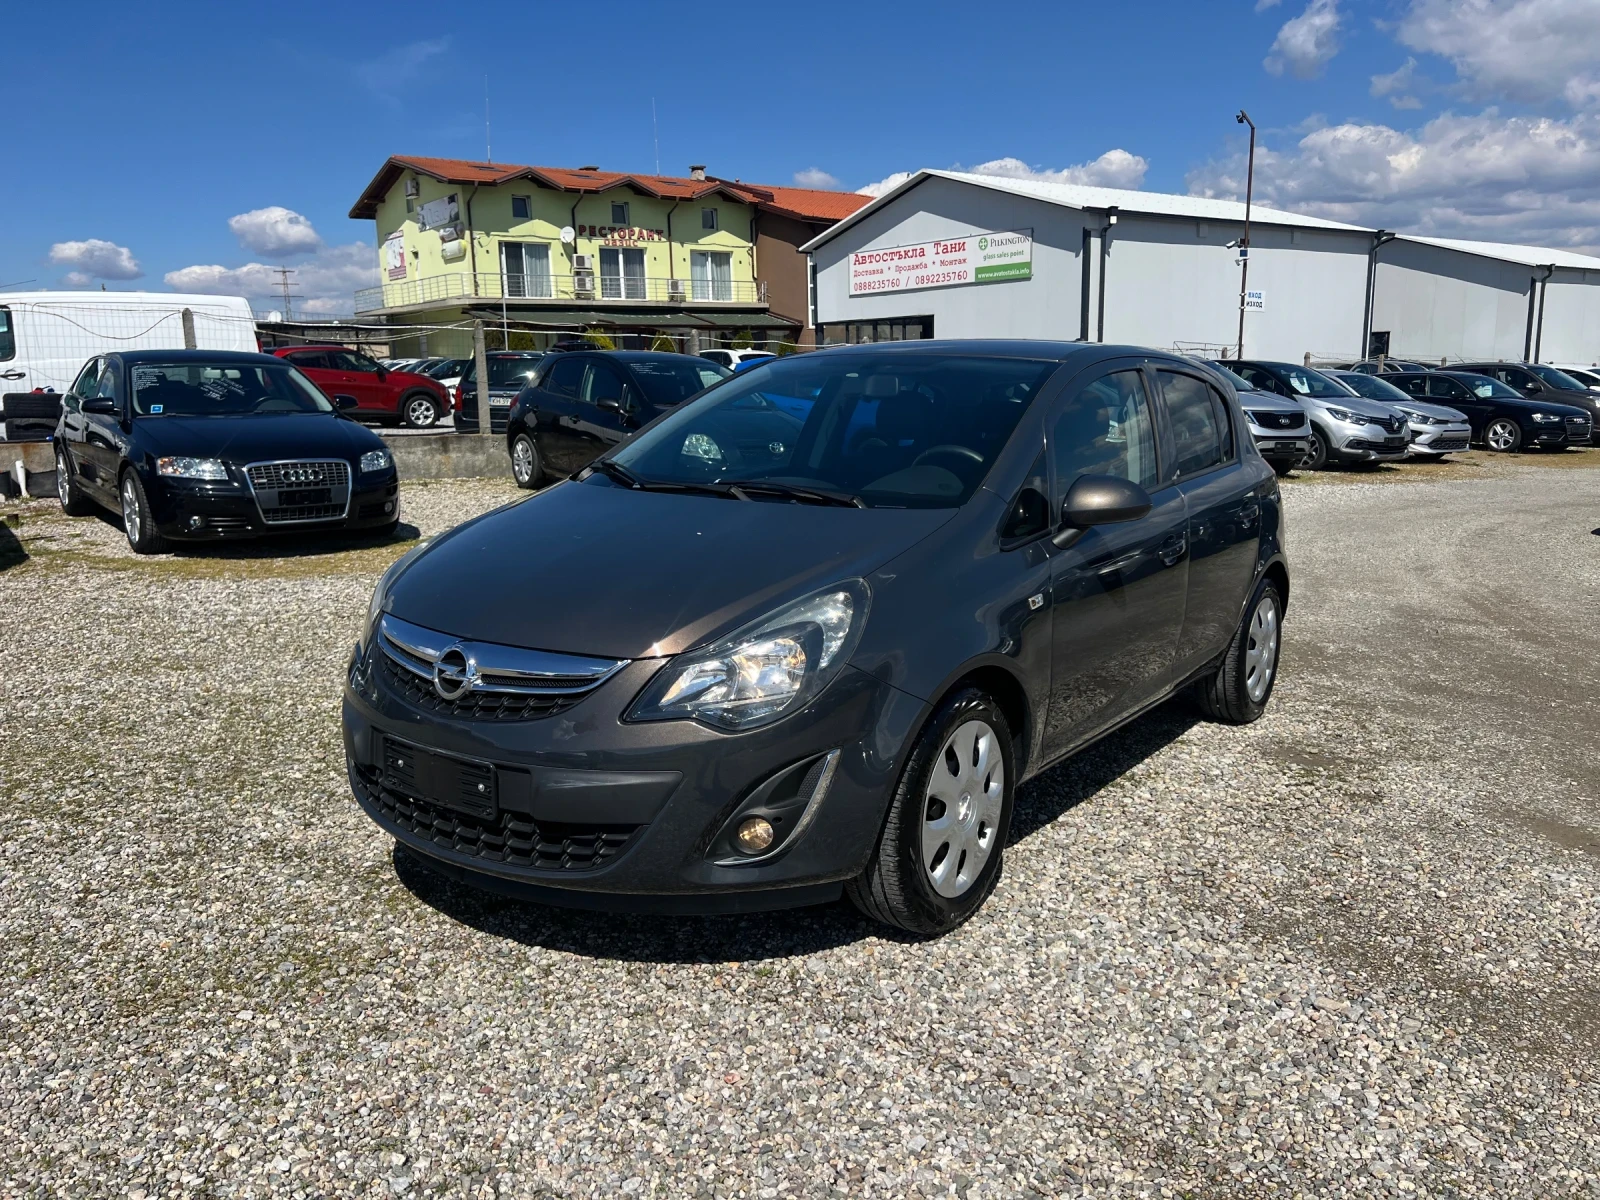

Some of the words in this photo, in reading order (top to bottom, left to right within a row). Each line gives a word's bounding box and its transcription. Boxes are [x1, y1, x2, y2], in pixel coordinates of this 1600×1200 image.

[578, 225, 664, 241] РЕСТОРАНТ
[990, 236, 1030, 247] PILKINGTON
[853, 248, 926, 265] Автостъкла
[933, 241, 967, 256] Тани
[983, 253, 996, 261] glass
[996, 251, 1010, 259] sales
[1010, 249, 1024, 258] point
[853, 268, 884, 278] Доставка
[895, 261, 928, 274] Продажба
[939, 257, 968, 267] Монтаж
[853, 278, 901, 291] 0888235760
[915, 269, 968, 285] 0892235760
